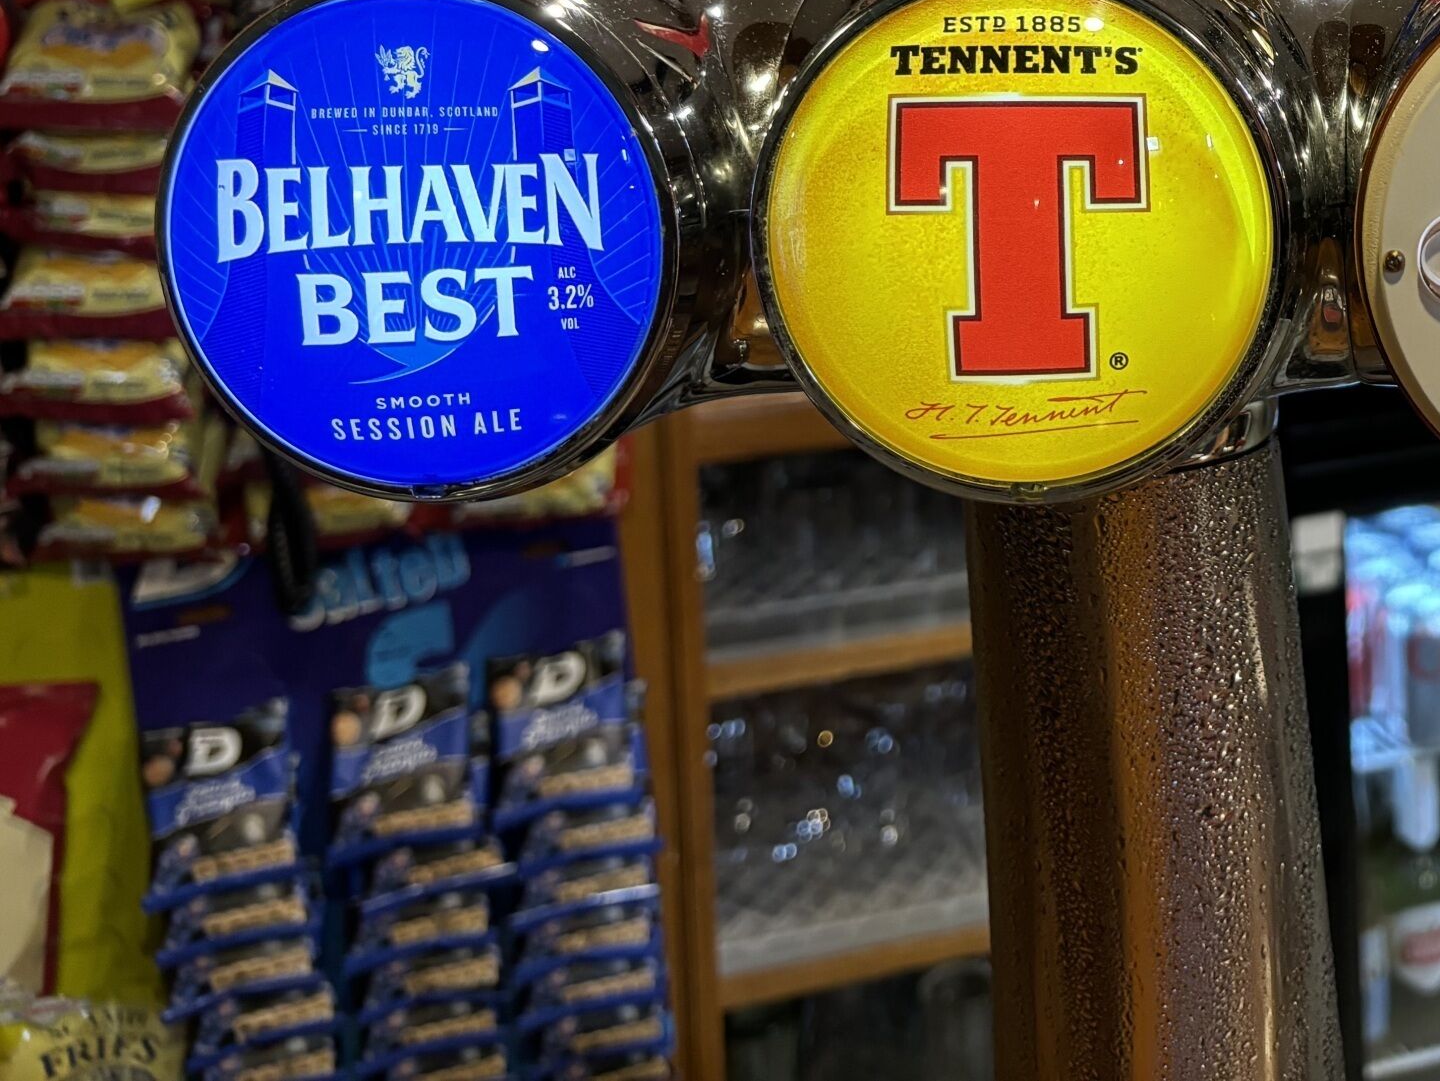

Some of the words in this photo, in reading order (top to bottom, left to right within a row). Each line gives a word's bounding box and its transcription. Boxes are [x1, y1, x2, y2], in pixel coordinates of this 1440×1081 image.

[943, 16, 1006, 33] ESTD
[1016, 16, 1081, 32] 1885
[890, 44, 1141, 76] TENNENT'S
[311, 107, 358, 120] BREWED
[363, 107, 376, 119] IN
[439, 106, 499, 118] SCOTLAND
[372, 123, 408, 136] SINCE
[414, 123, 439, 135] 1719
[215, 152, 604, 264] BELHAVEN
[886, 93, 1150, 385] T
[558, 266, 577, 279] ALC
[295, 265, 535, 347] BEST
[547, 284, 594, 311] 3.2%
[560, 317, 580, 331] VOL
[375, 392, 472, 410] SMOOTH
[331, 414, 457, 441] SESSION
[473, 408, 522, 434] ALE
